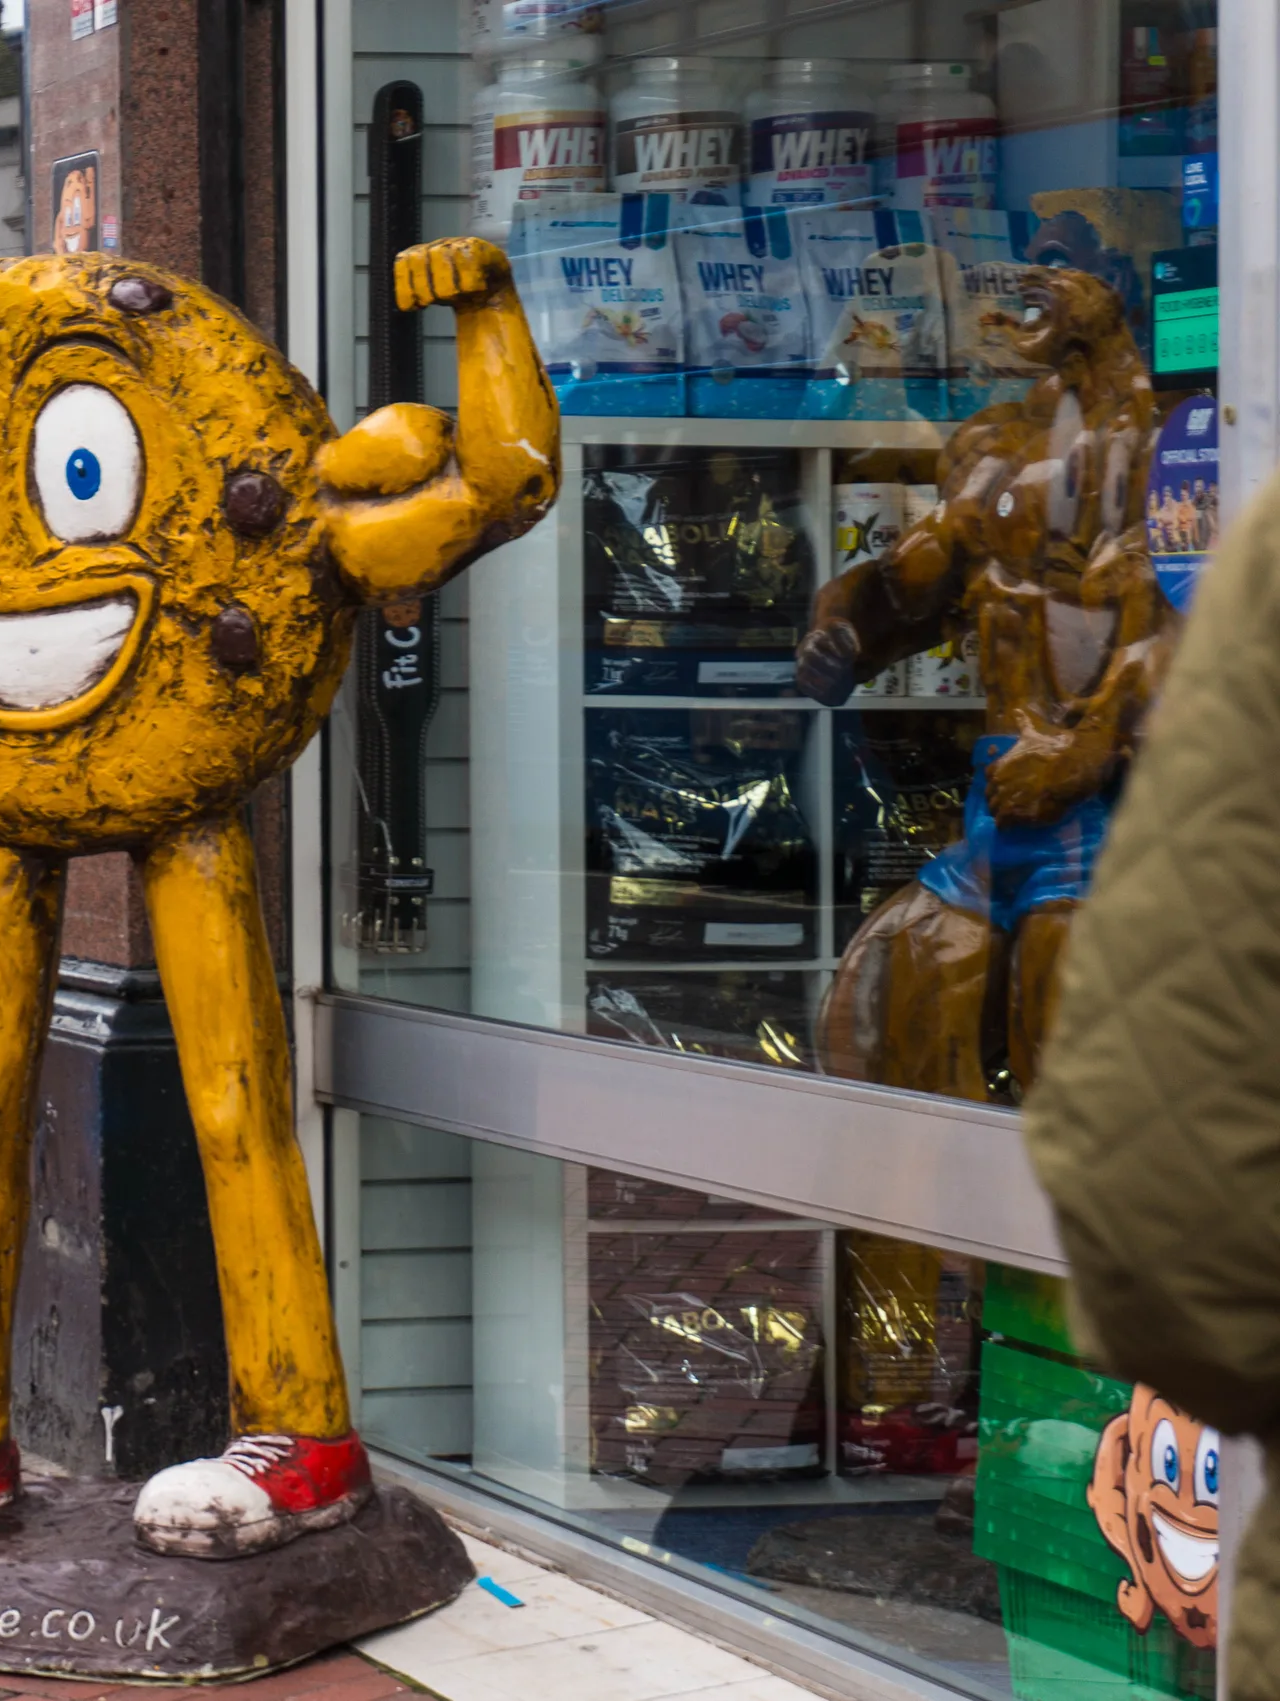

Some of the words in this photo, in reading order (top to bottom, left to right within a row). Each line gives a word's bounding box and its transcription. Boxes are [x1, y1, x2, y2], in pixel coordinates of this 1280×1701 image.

[517, 126, 602, 168] WHE
[633, 128, 734, 172] WHEY
[771, 127, 869, 170] WHEY
[923, 135, 996, 176] WHE
[560, 256, 634, 287] WHEY
[697, 261, 765, 293] WHEY
[821, 266, 895, 297] WHEY
[600, 287, 665, 303] DELICIOUS
